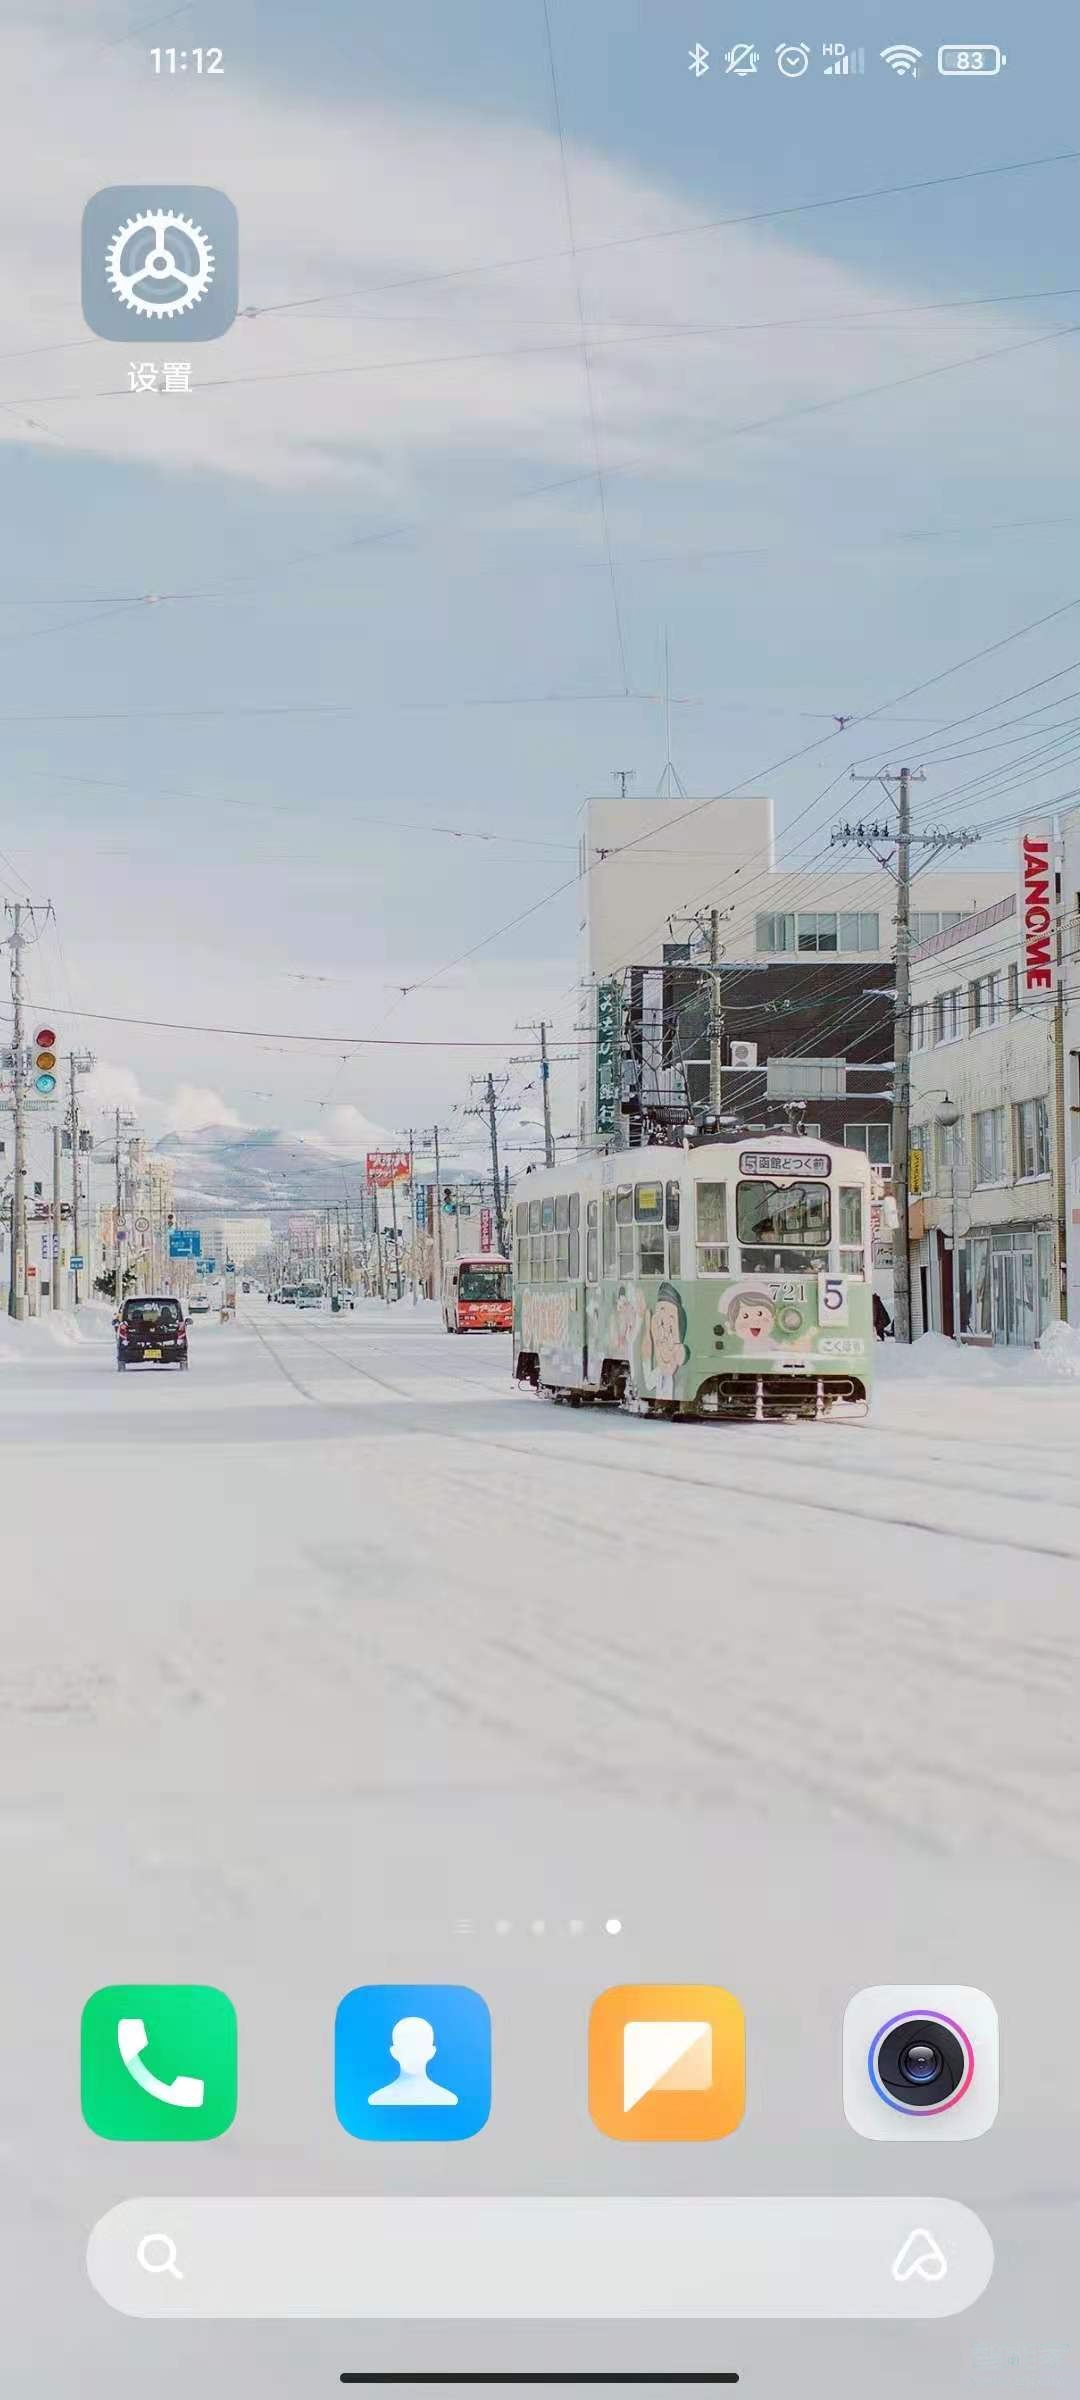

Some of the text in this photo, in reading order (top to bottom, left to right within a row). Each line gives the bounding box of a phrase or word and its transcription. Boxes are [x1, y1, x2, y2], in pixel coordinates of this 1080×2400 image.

[150, 47, 225, 74] 11:12
[822, 43, 846, 56] HD
[956, 51, 984, 70] 83
[127, 361, 193, 392] 设置
[1024, 834, 1051, 989] JANOME
[768, 1283, 808, 1302] 721
[823, 1279, 843, 1311] 5
